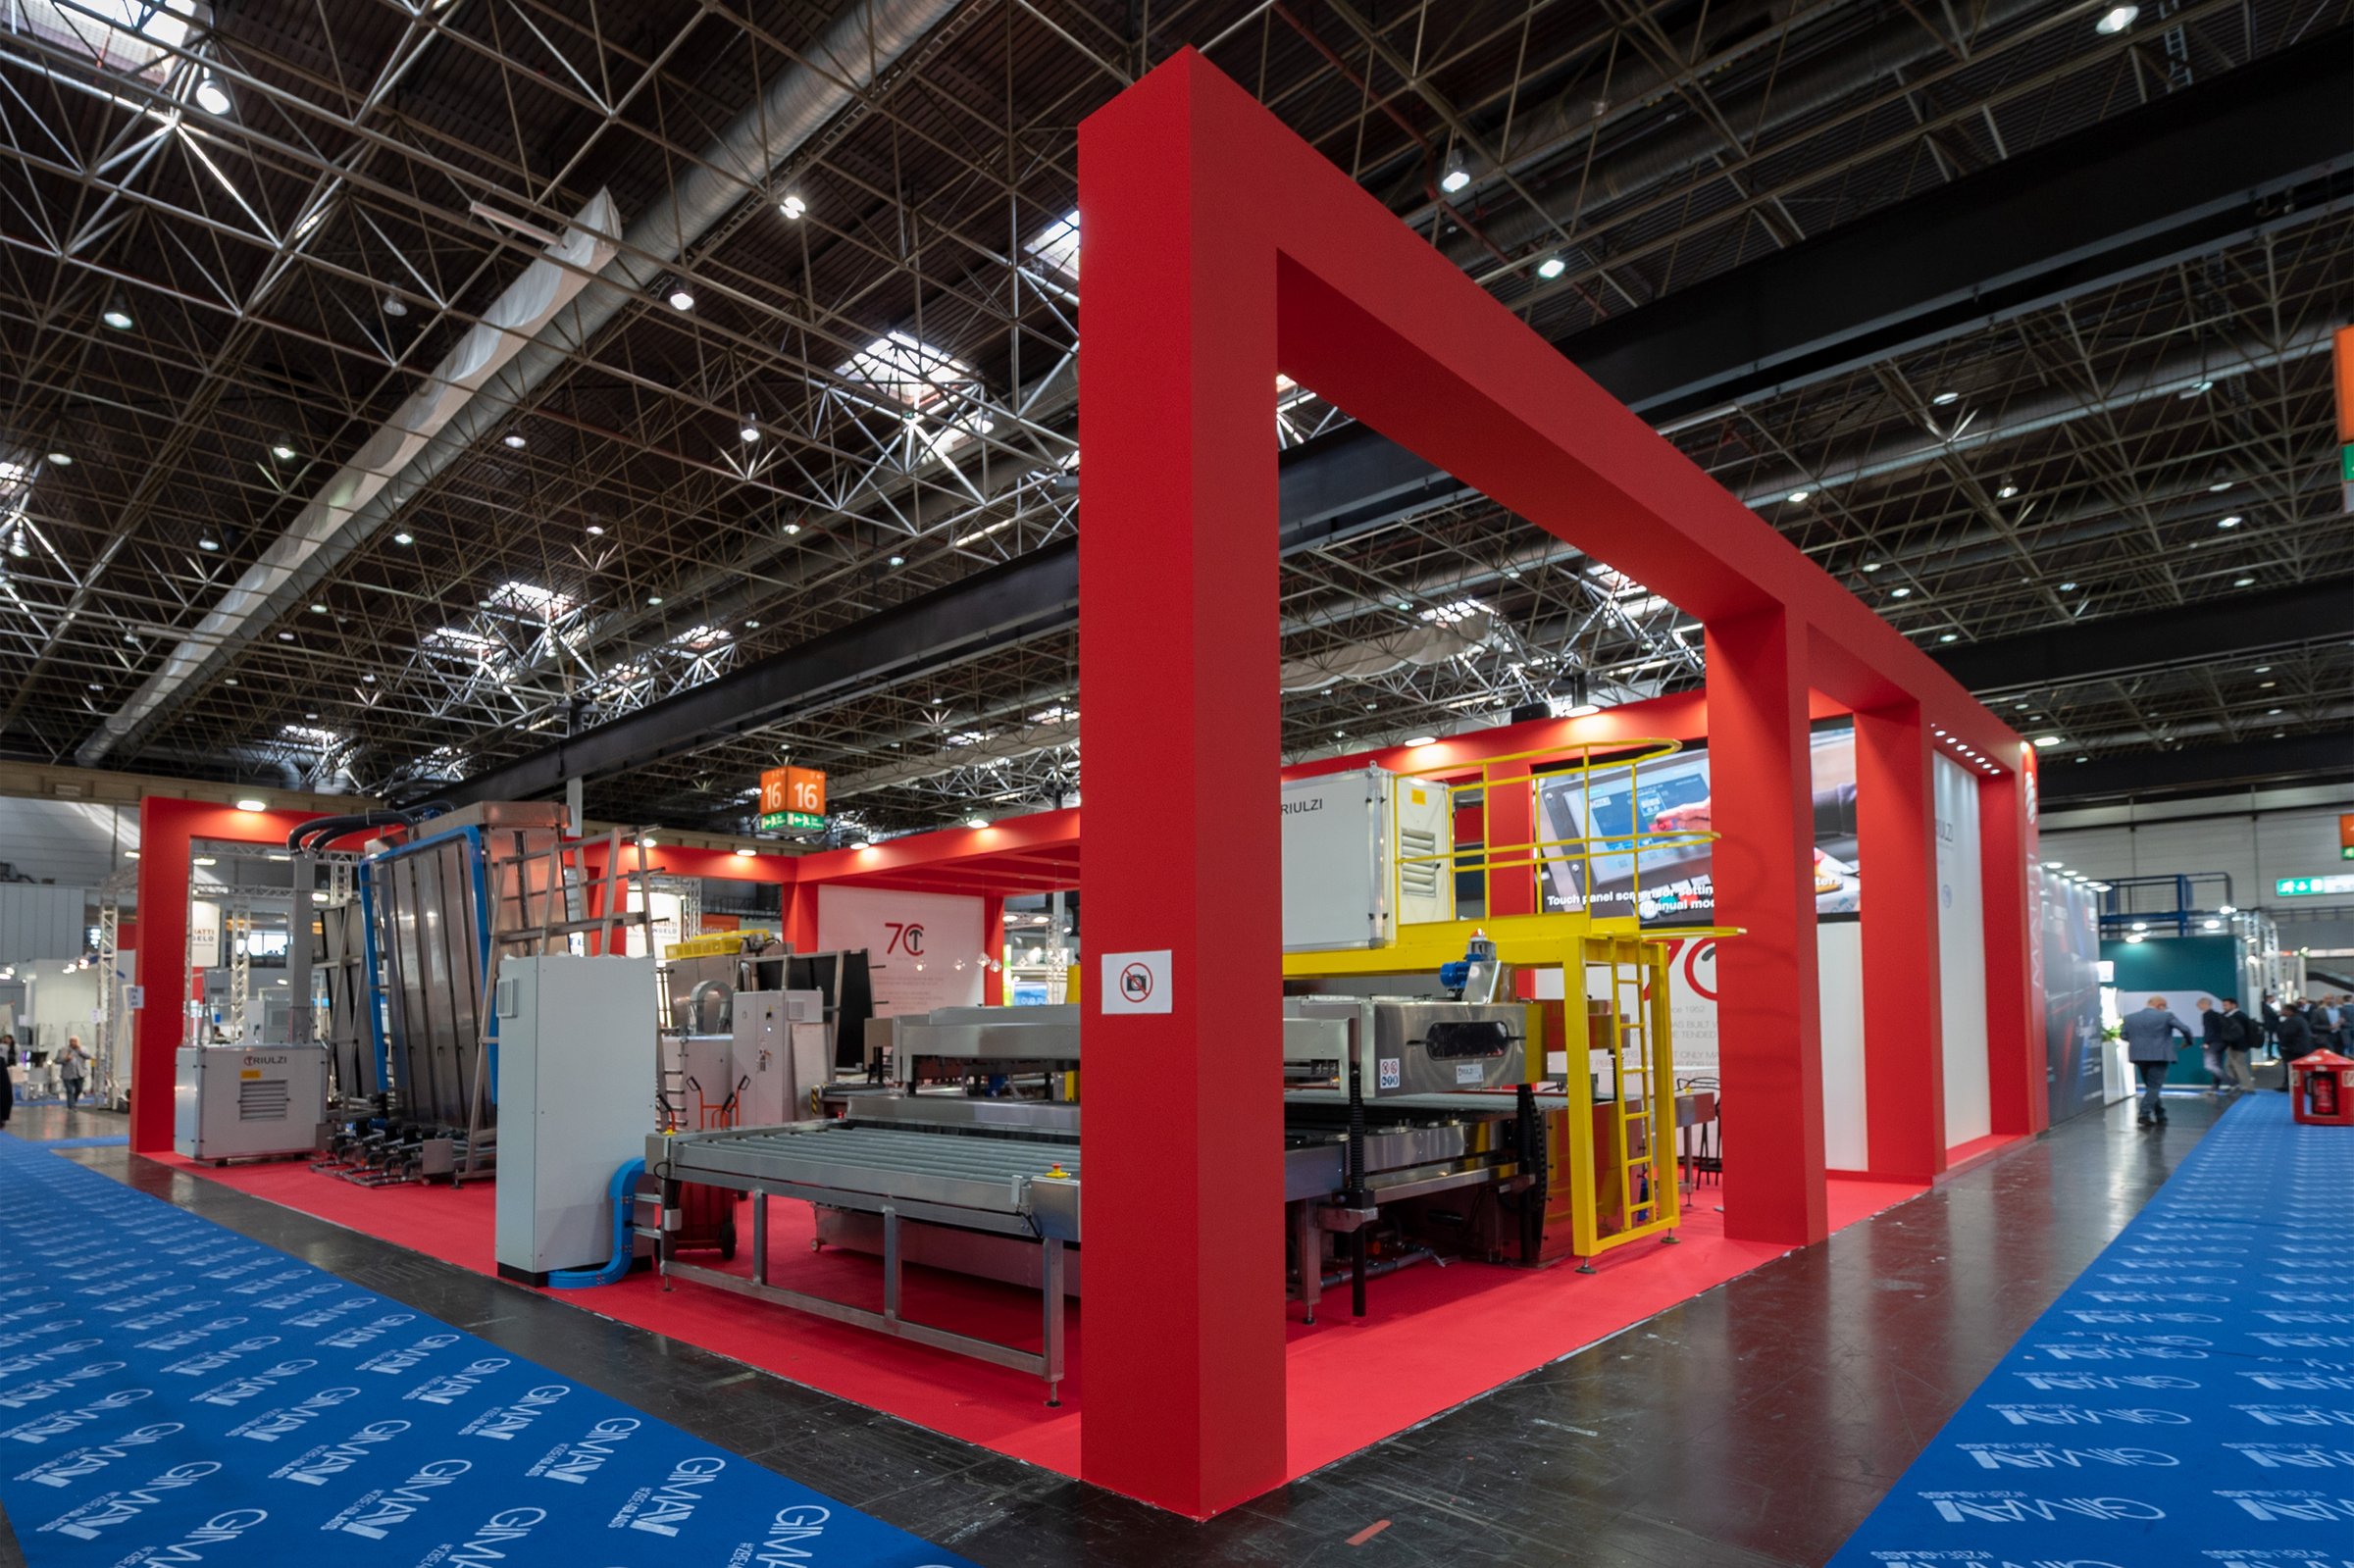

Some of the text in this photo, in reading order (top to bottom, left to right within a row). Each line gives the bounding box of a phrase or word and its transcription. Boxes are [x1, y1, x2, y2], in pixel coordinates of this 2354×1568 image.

[765, 782, 782, 810] 16
[793, 782, 818, 810] 16
[1281, 797, 1323, 816] RIULZI
[1547, 895, 1580, 906] Touch
[373, 1335, 460, 1374] GIMAV
[207, 1359, 318, 1406] GIMAV
[420, 1358, 511, 1404] GIMAV
[2024, 1376, 2201, 1390] GIMAV
[17, 1389, 153, 1443] GIMAV
[243, 1387, 361, 1442] GIMAV
[477, 1386, 571, 1441] GIMAV
[1999, 1408, 2191, 1425] GIMAV
[32, 1422, 185, 1488] GIMAV
[287, 1420, 412, 1486] GIMAV
[543, 1418, 640, 1485] GIMAV
[1970, 1448, 2180, 1469] GIMAV
[57, 1461, 222, 1541] GIMAV
[340, 1459, 472, 1540] GIMAV
[628, 1457, 726, 1537] GIMAV
[1932, 1497, 2166, 1522] GIMAV
